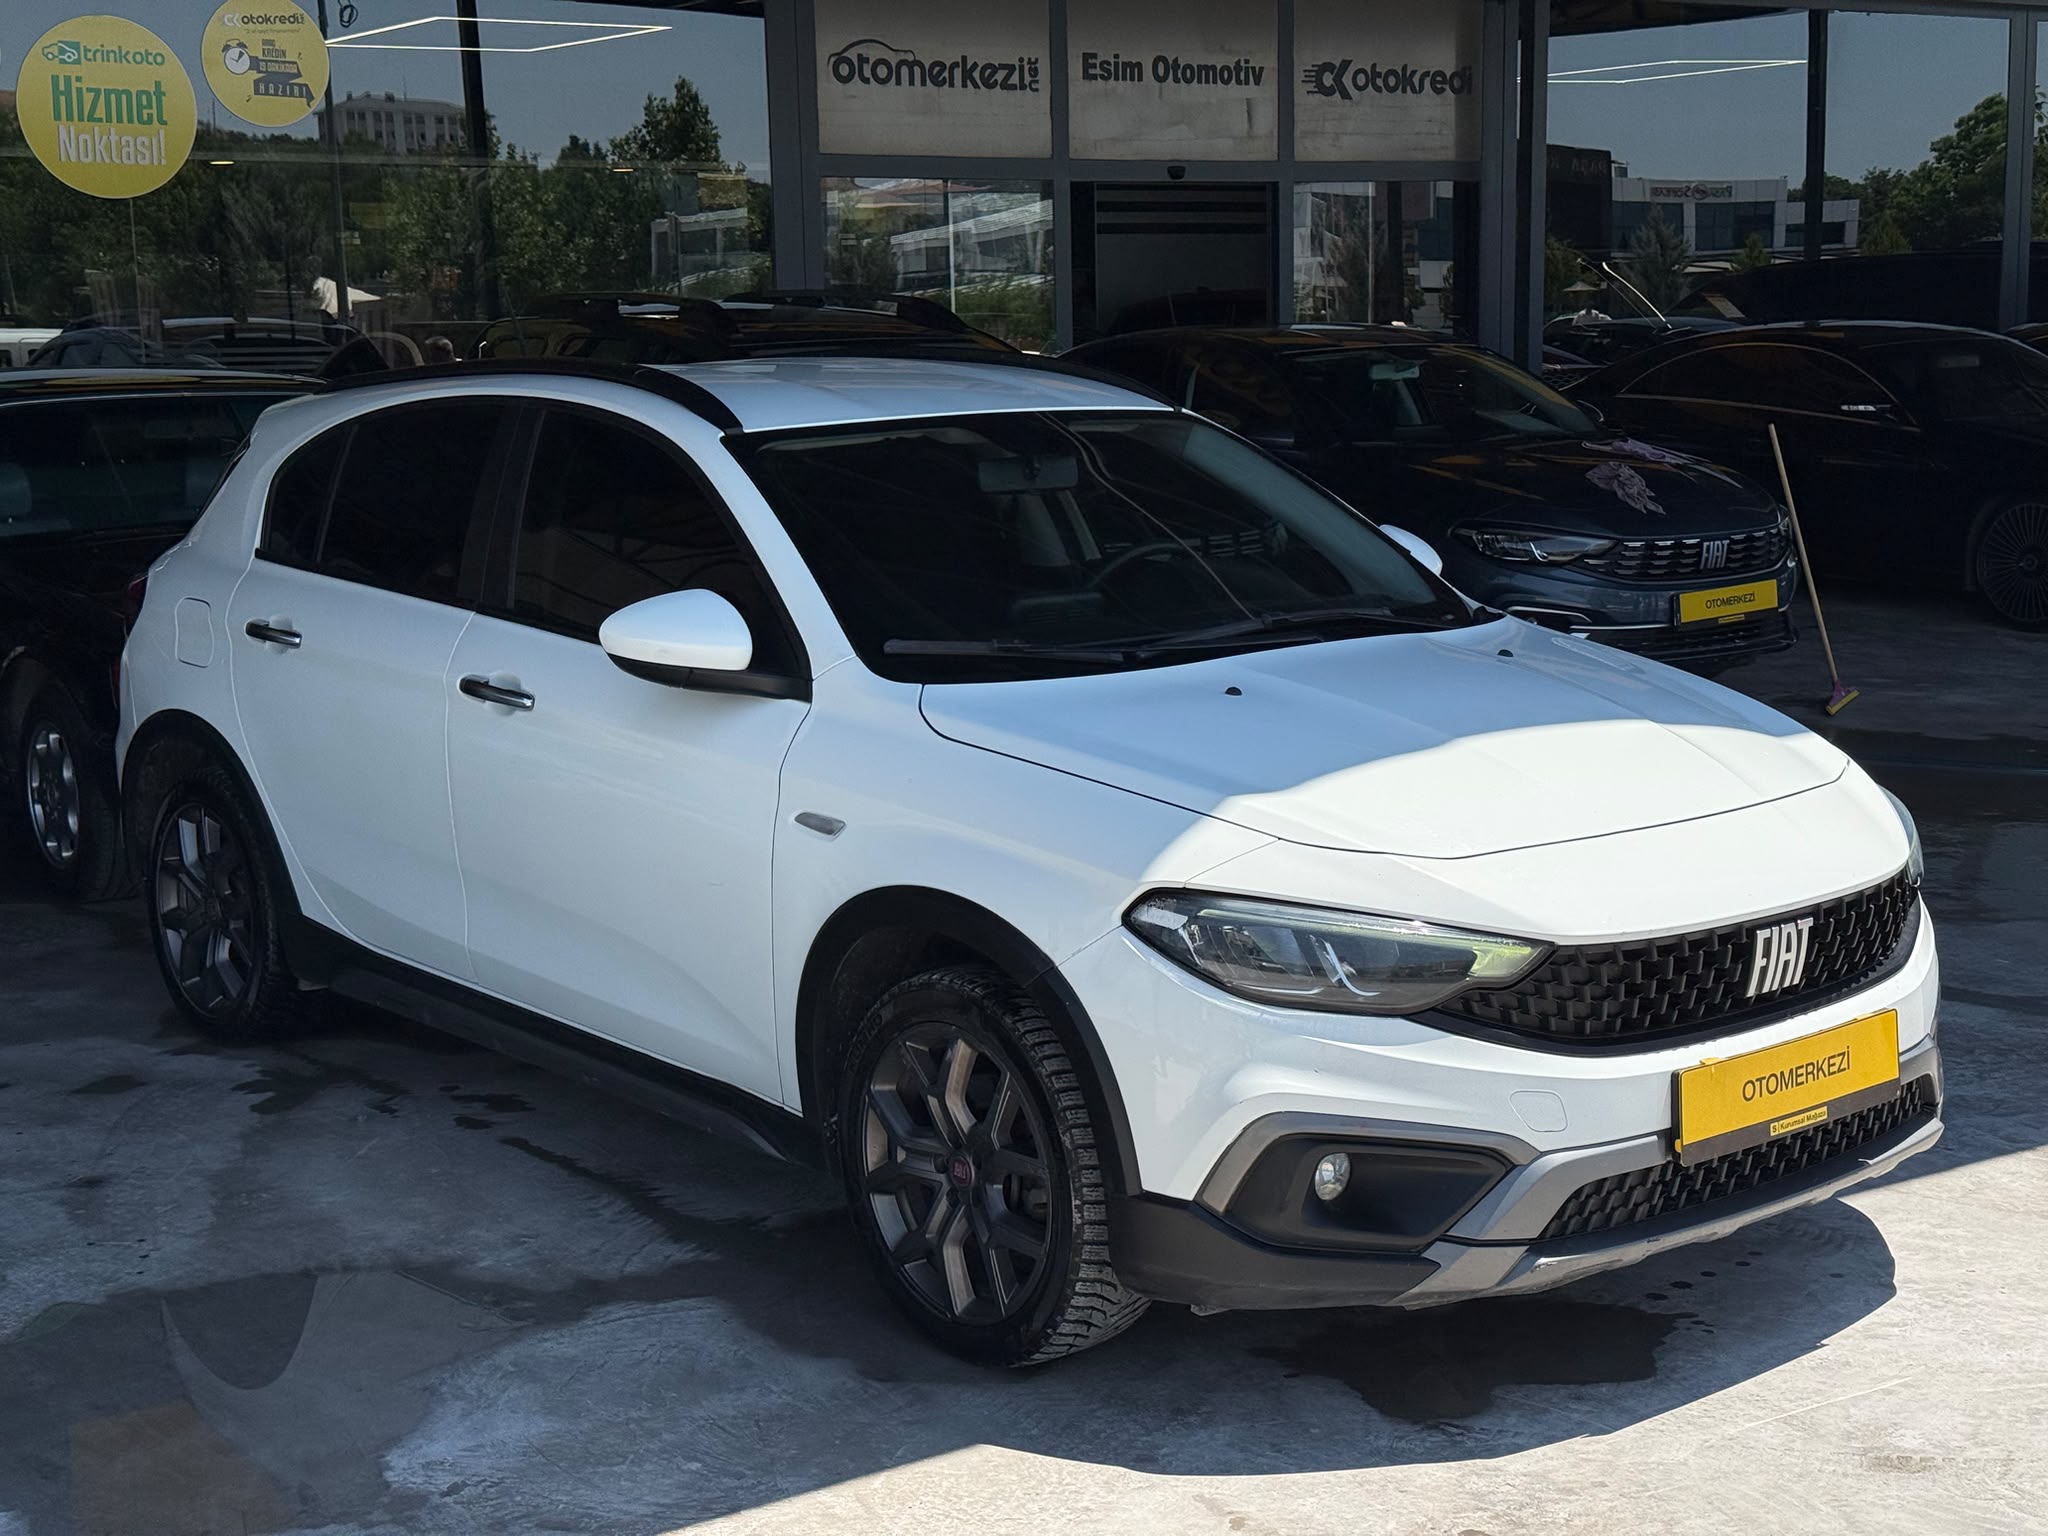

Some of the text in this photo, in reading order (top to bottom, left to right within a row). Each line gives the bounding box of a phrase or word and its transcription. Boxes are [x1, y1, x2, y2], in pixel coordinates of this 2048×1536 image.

[83, 44, 165, 66] trinkoto
[832, 53, 1028, 91] otomerkezi
[1082, 52, 1265, 86] Esim Otomotiv
[1351, 62, 1473, 96] otokredi
[51, 74, 168, 126] Hizmet
[57, 125, 167, 166] Noktası!
[1700, 540, 1730, 569] FIAT
[1746, 917, 1814, 998] FIAT
[1742, 1045, 1851, 1102] OTOMERKEZİ
[1780, 1115, 1806, 1131] Kurumsal
